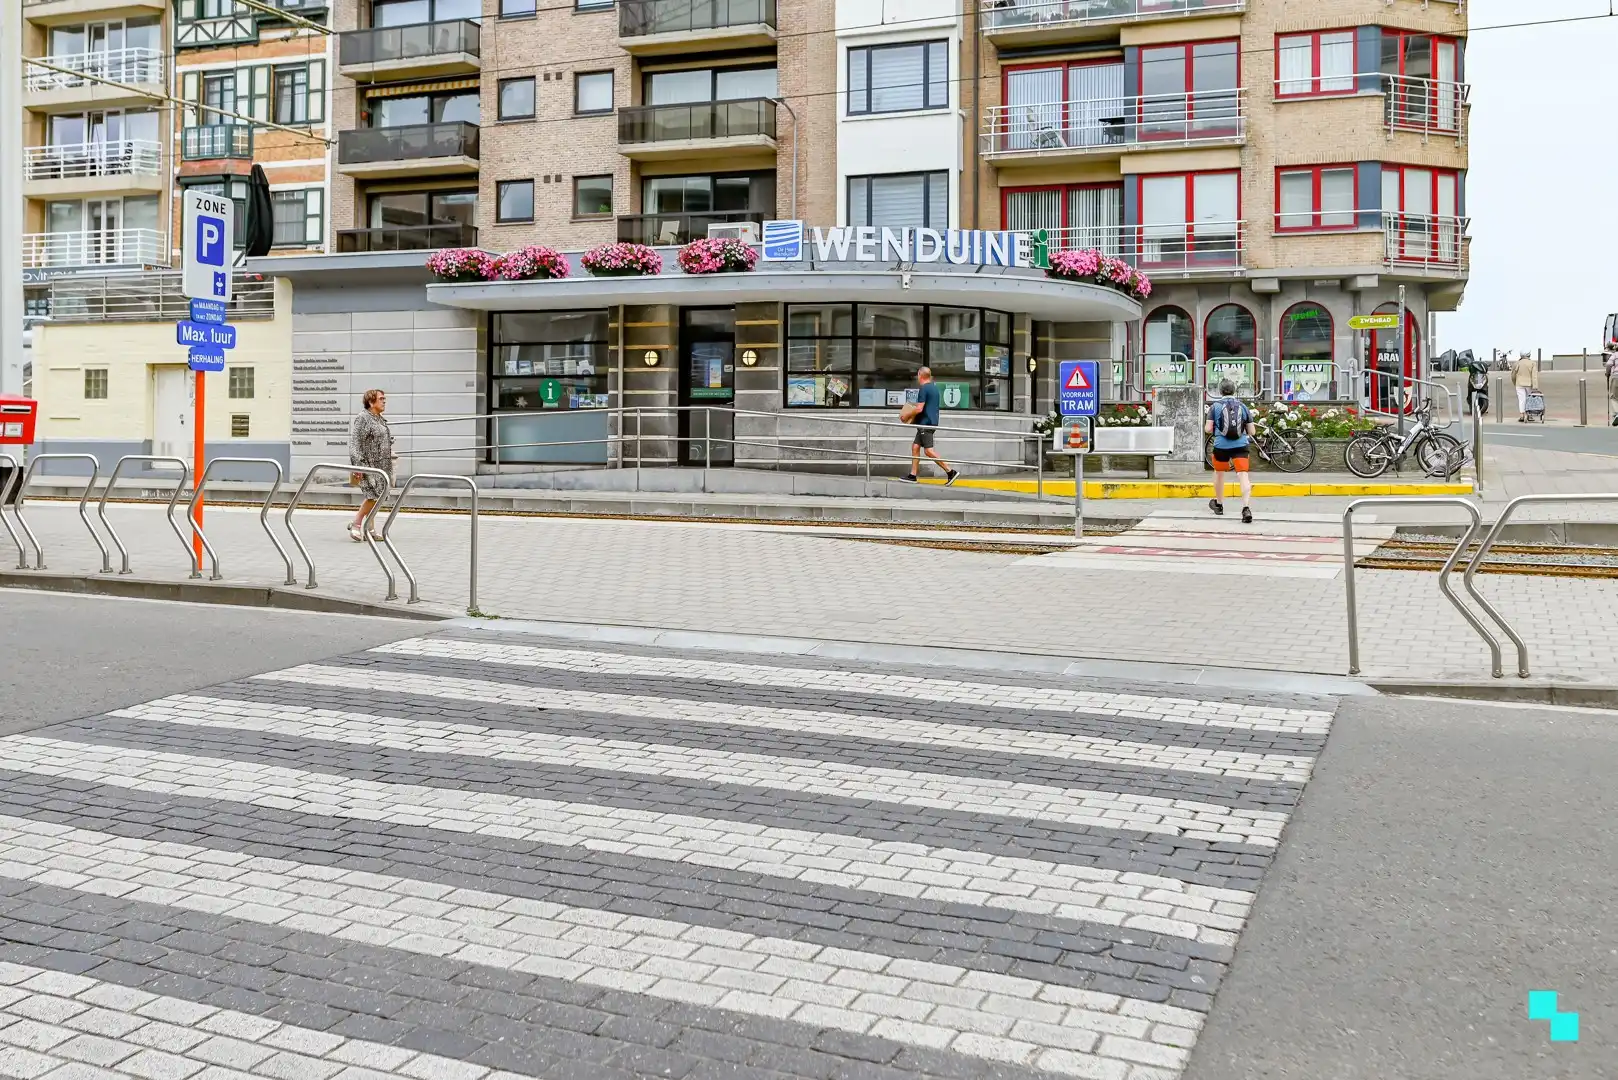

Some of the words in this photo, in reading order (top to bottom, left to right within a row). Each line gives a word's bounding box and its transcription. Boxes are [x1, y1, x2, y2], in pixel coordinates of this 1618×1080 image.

[196, 198, 226, 214] ZONE
[202, 222, 219, 258] P
[813, 226, 1030, 267] WENDUINE
[182, 325, 208, 343] Max.
[210, 327, 233, 345] 1uur
[191, 354, 224, 364] HERHALING
[1290, 364, 1323, 372] ARAV
[1062, 400, 1093, 410] TRAM
